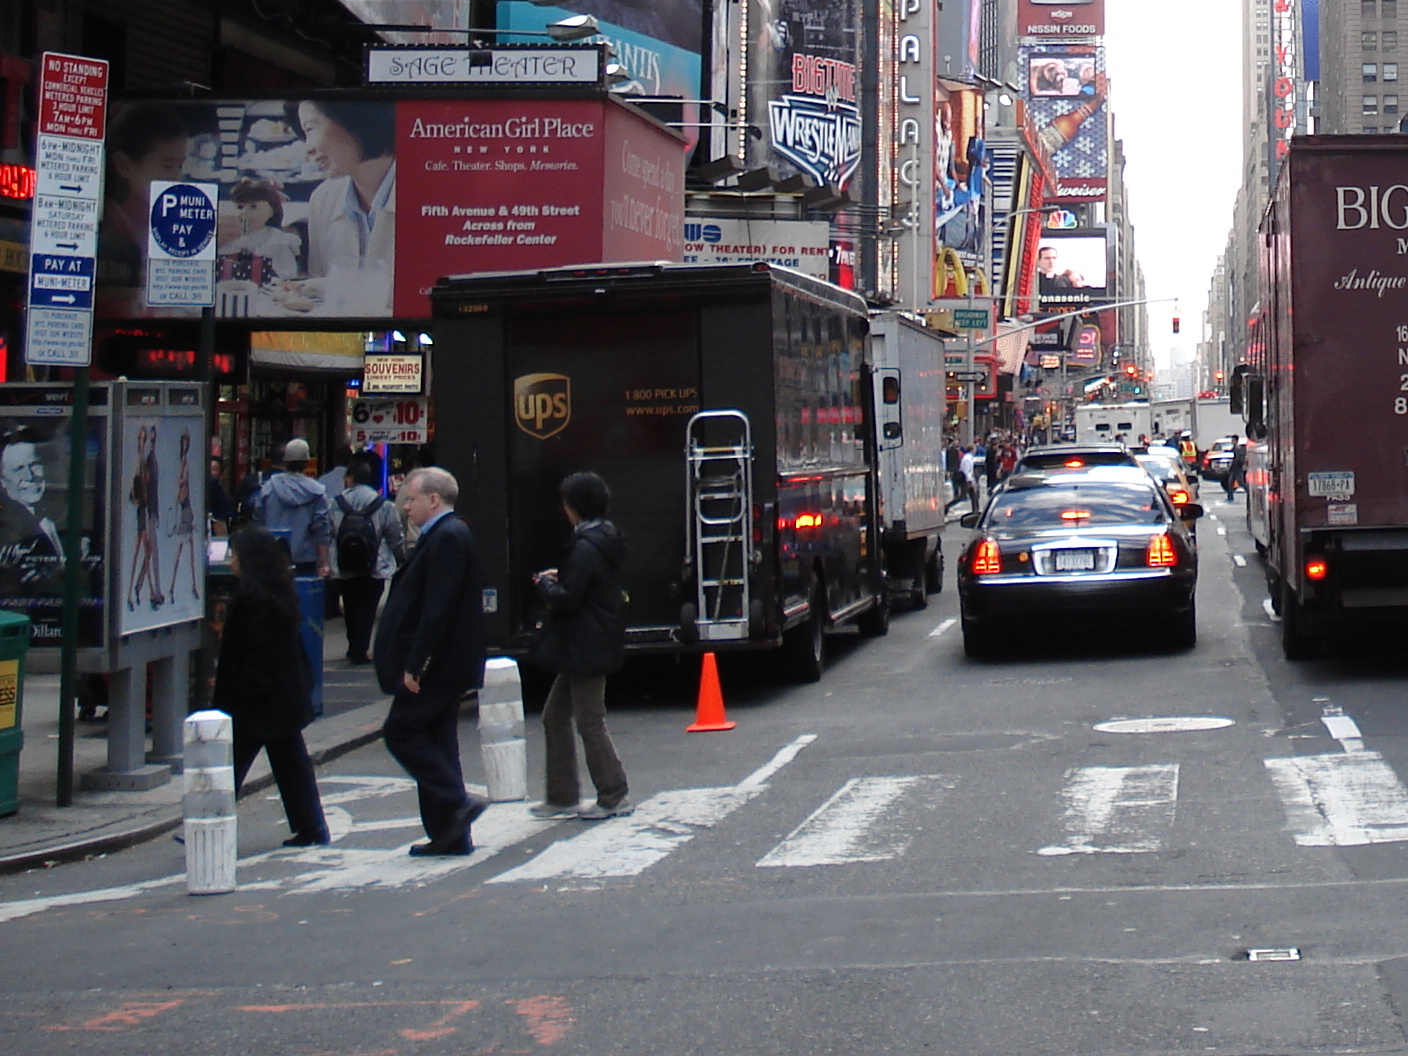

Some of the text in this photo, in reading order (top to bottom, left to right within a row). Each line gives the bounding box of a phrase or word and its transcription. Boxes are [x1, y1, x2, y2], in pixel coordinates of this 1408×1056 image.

[1027, 25, 1096, 34] NISSIN FOODS
[49, 59, 103, 79] NO STANDING
[390, 56, 456, 77] SAGE
[793, 52, 825, 96] BIG
[84, 127, 98, 136] FRI
[409, 116, 595, 138] American Girl Place
[453, 146, 550, 154] NEW YORK
[452, 160, 492, 171] Theater.
[494, 160, 527, 173] Shops.
[162, 193, 206, 218] P MUNI
[421, 205, 580, 217] Fifth Avenue & 49th Street
[180, 208, 214, 220] METER
[172, 224, 194, 235] PAY
[462, 219, 536, 231] Across from
[444, 234, 557, 246] Rockefeller Center
[709, 245, 767, 255] THEATER)
[772, 246, 796, 255] FOR
[801, 247, 830, 256] RENT
[45, 258, 83, 272] PAY AT
[37, 275, 88, 290] MUNI-METER
[1334, 268, 1407, 298] Antique
[364, 363, 420, 375] SOUVENIRS
[655, 388, 677, 399] PICK
[680, 387, 698, 398] UPS
[519, 393, 567, 430] ups
